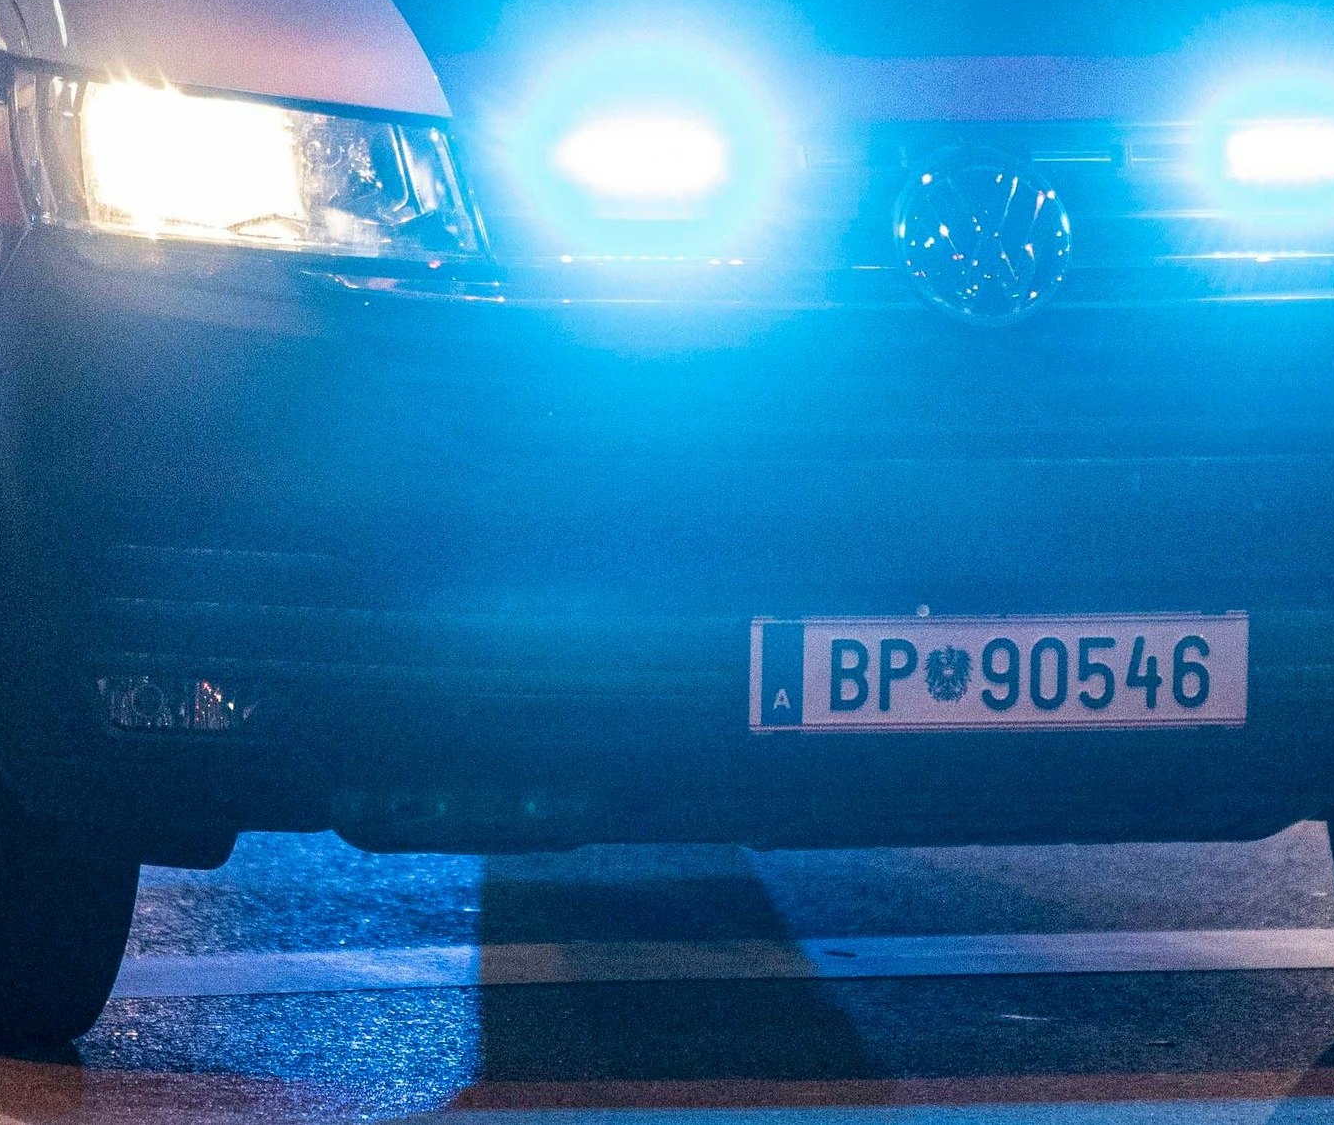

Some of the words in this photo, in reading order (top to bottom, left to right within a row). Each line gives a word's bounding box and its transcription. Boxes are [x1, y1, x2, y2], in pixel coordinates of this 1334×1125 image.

[771, 687, 792, 711] A
[829, 636, 920, 713] BP
[980, 634, 1211, 712] 90546
